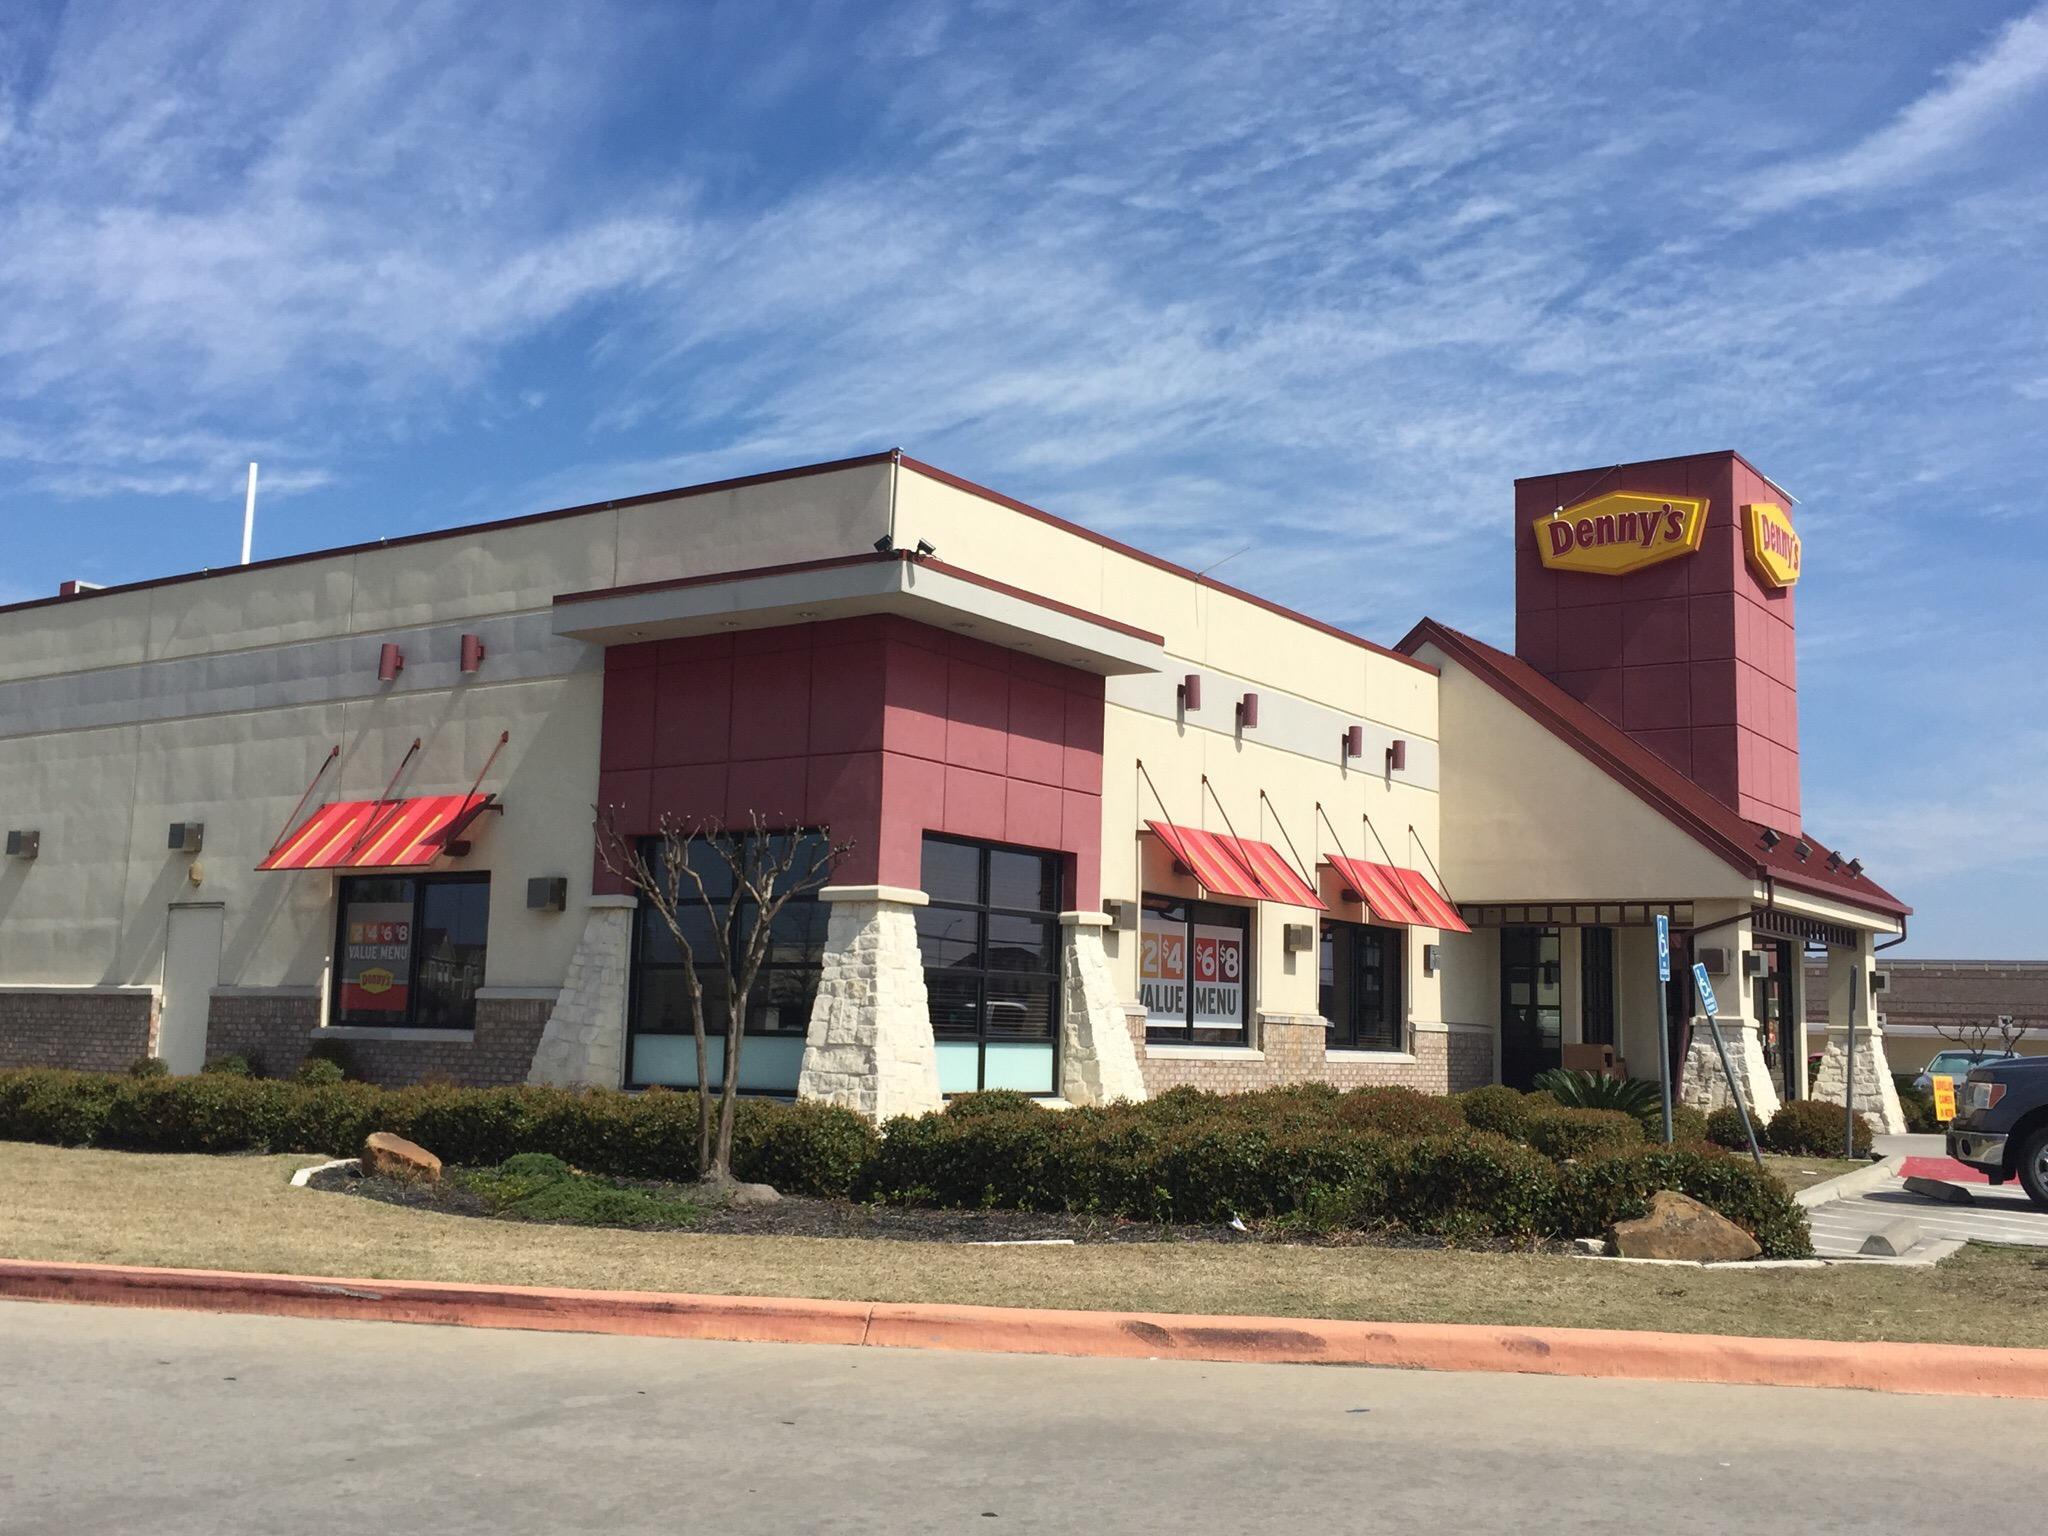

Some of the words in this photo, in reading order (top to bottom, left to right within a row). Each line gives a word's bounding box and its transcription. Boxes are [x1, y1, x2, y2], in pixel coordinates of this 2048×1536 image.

[1547, 502, 1686, 558] Denny's
[1761, 513, 1800, 570] Denny's
[349, 945, 377, 960] VALUE
[381, 945, 408, 960] MENU
[1163, 938, 1183, 974] $4
[1196, 943, 1215, 976] $6
[1220, 944, 1239, 978] $8
[1140, 984, 1184, 1014] VALUE
[1196, 987, 1237, 1015] MENU
